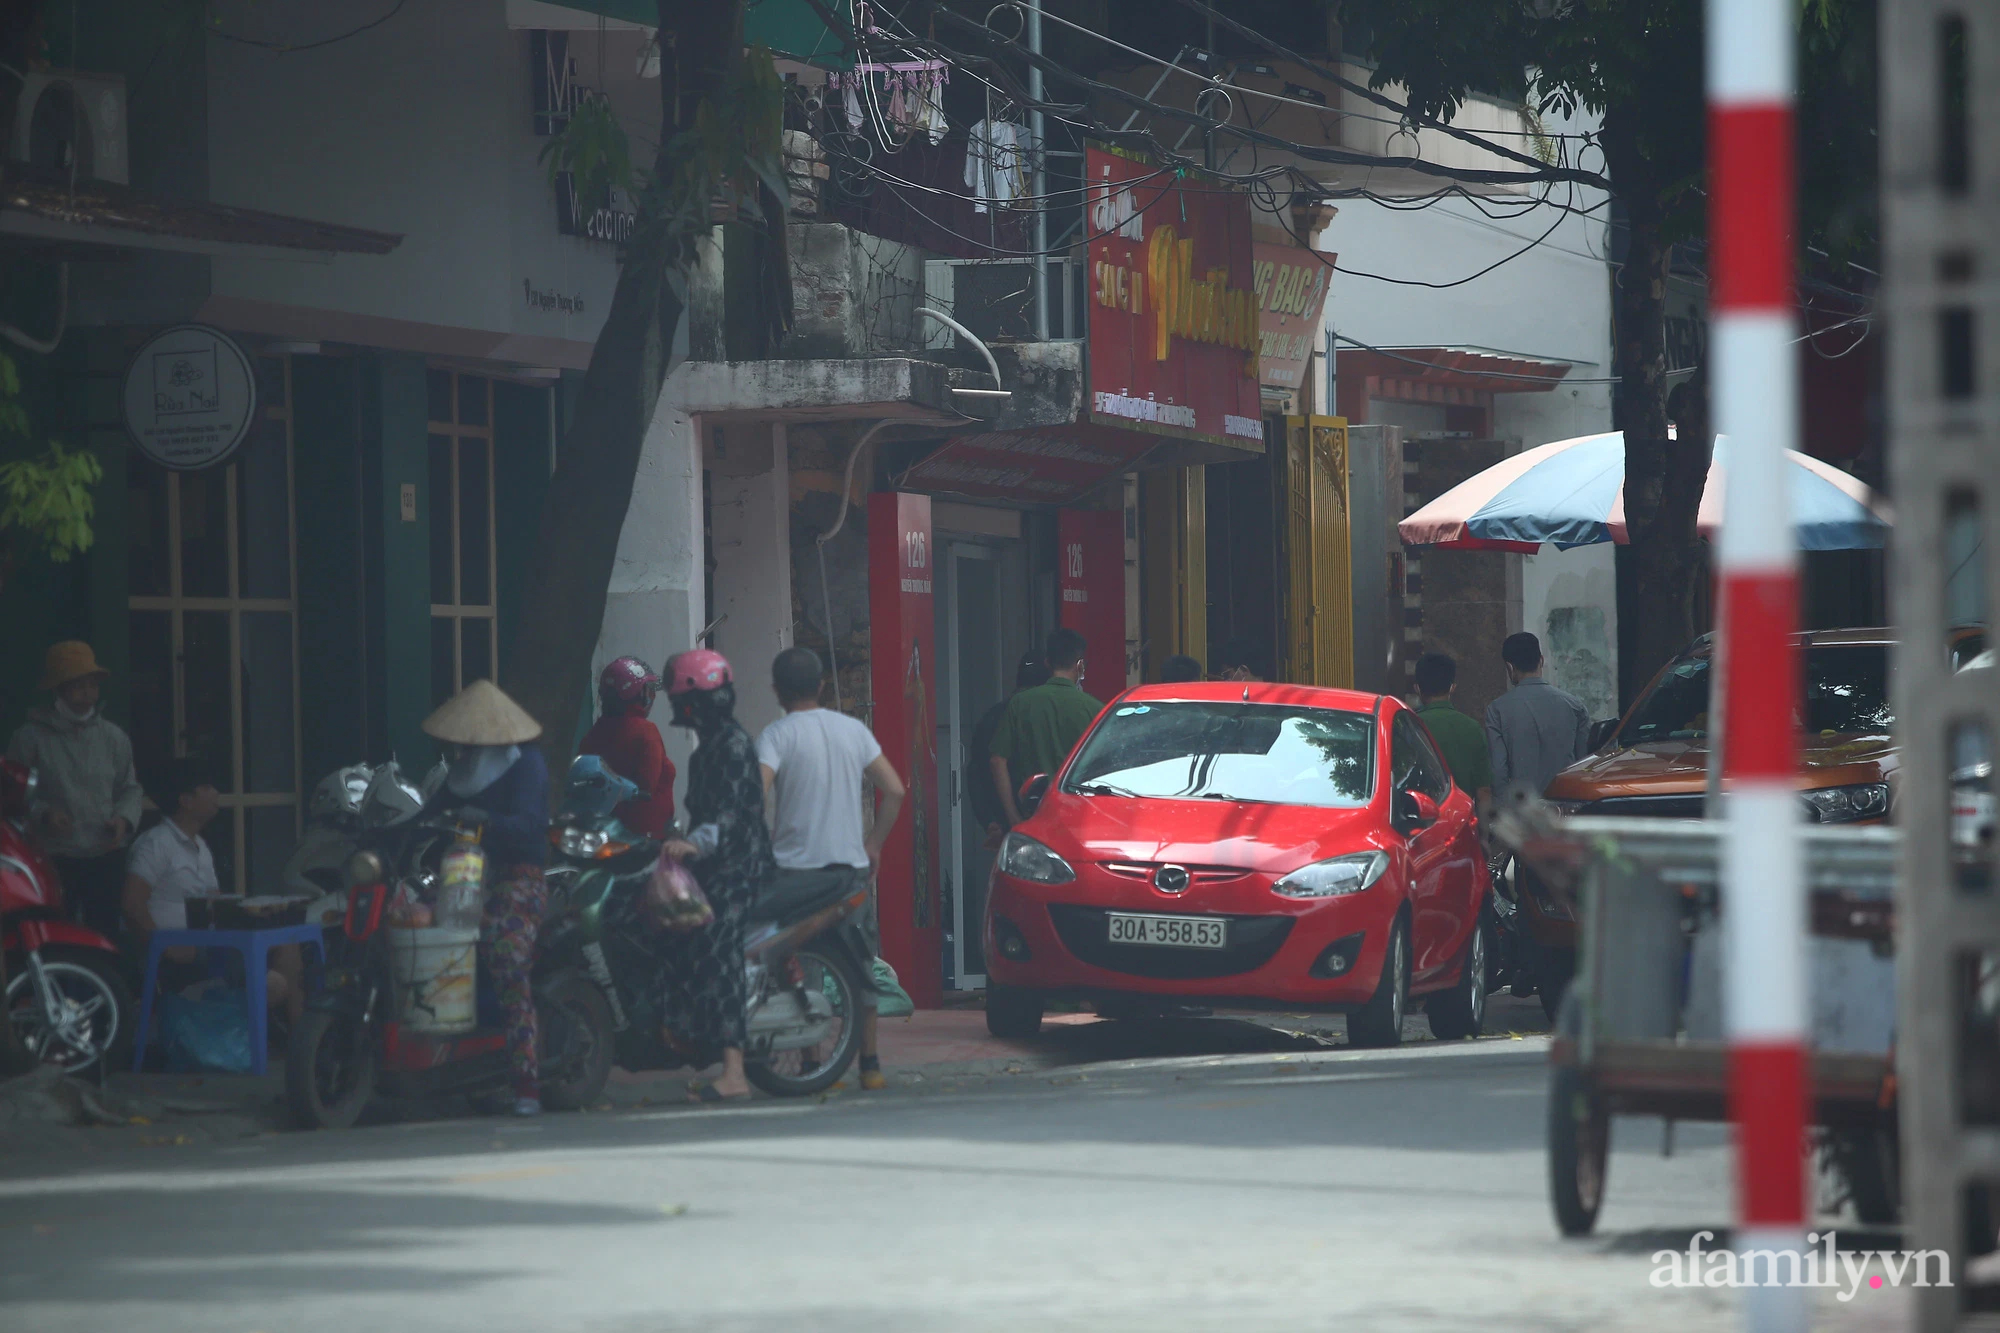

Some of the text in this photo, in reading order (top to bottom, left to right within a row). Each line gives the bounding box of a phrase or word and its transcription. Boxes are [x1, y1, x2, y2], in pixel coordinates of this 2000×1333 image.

[1269, 263, 1312, 325] BẠC
[906, 531, 925, 568] 126
[1066, 543, 1083, 578] 126
[1111, 918, 1221, 945] 30A-558.53
